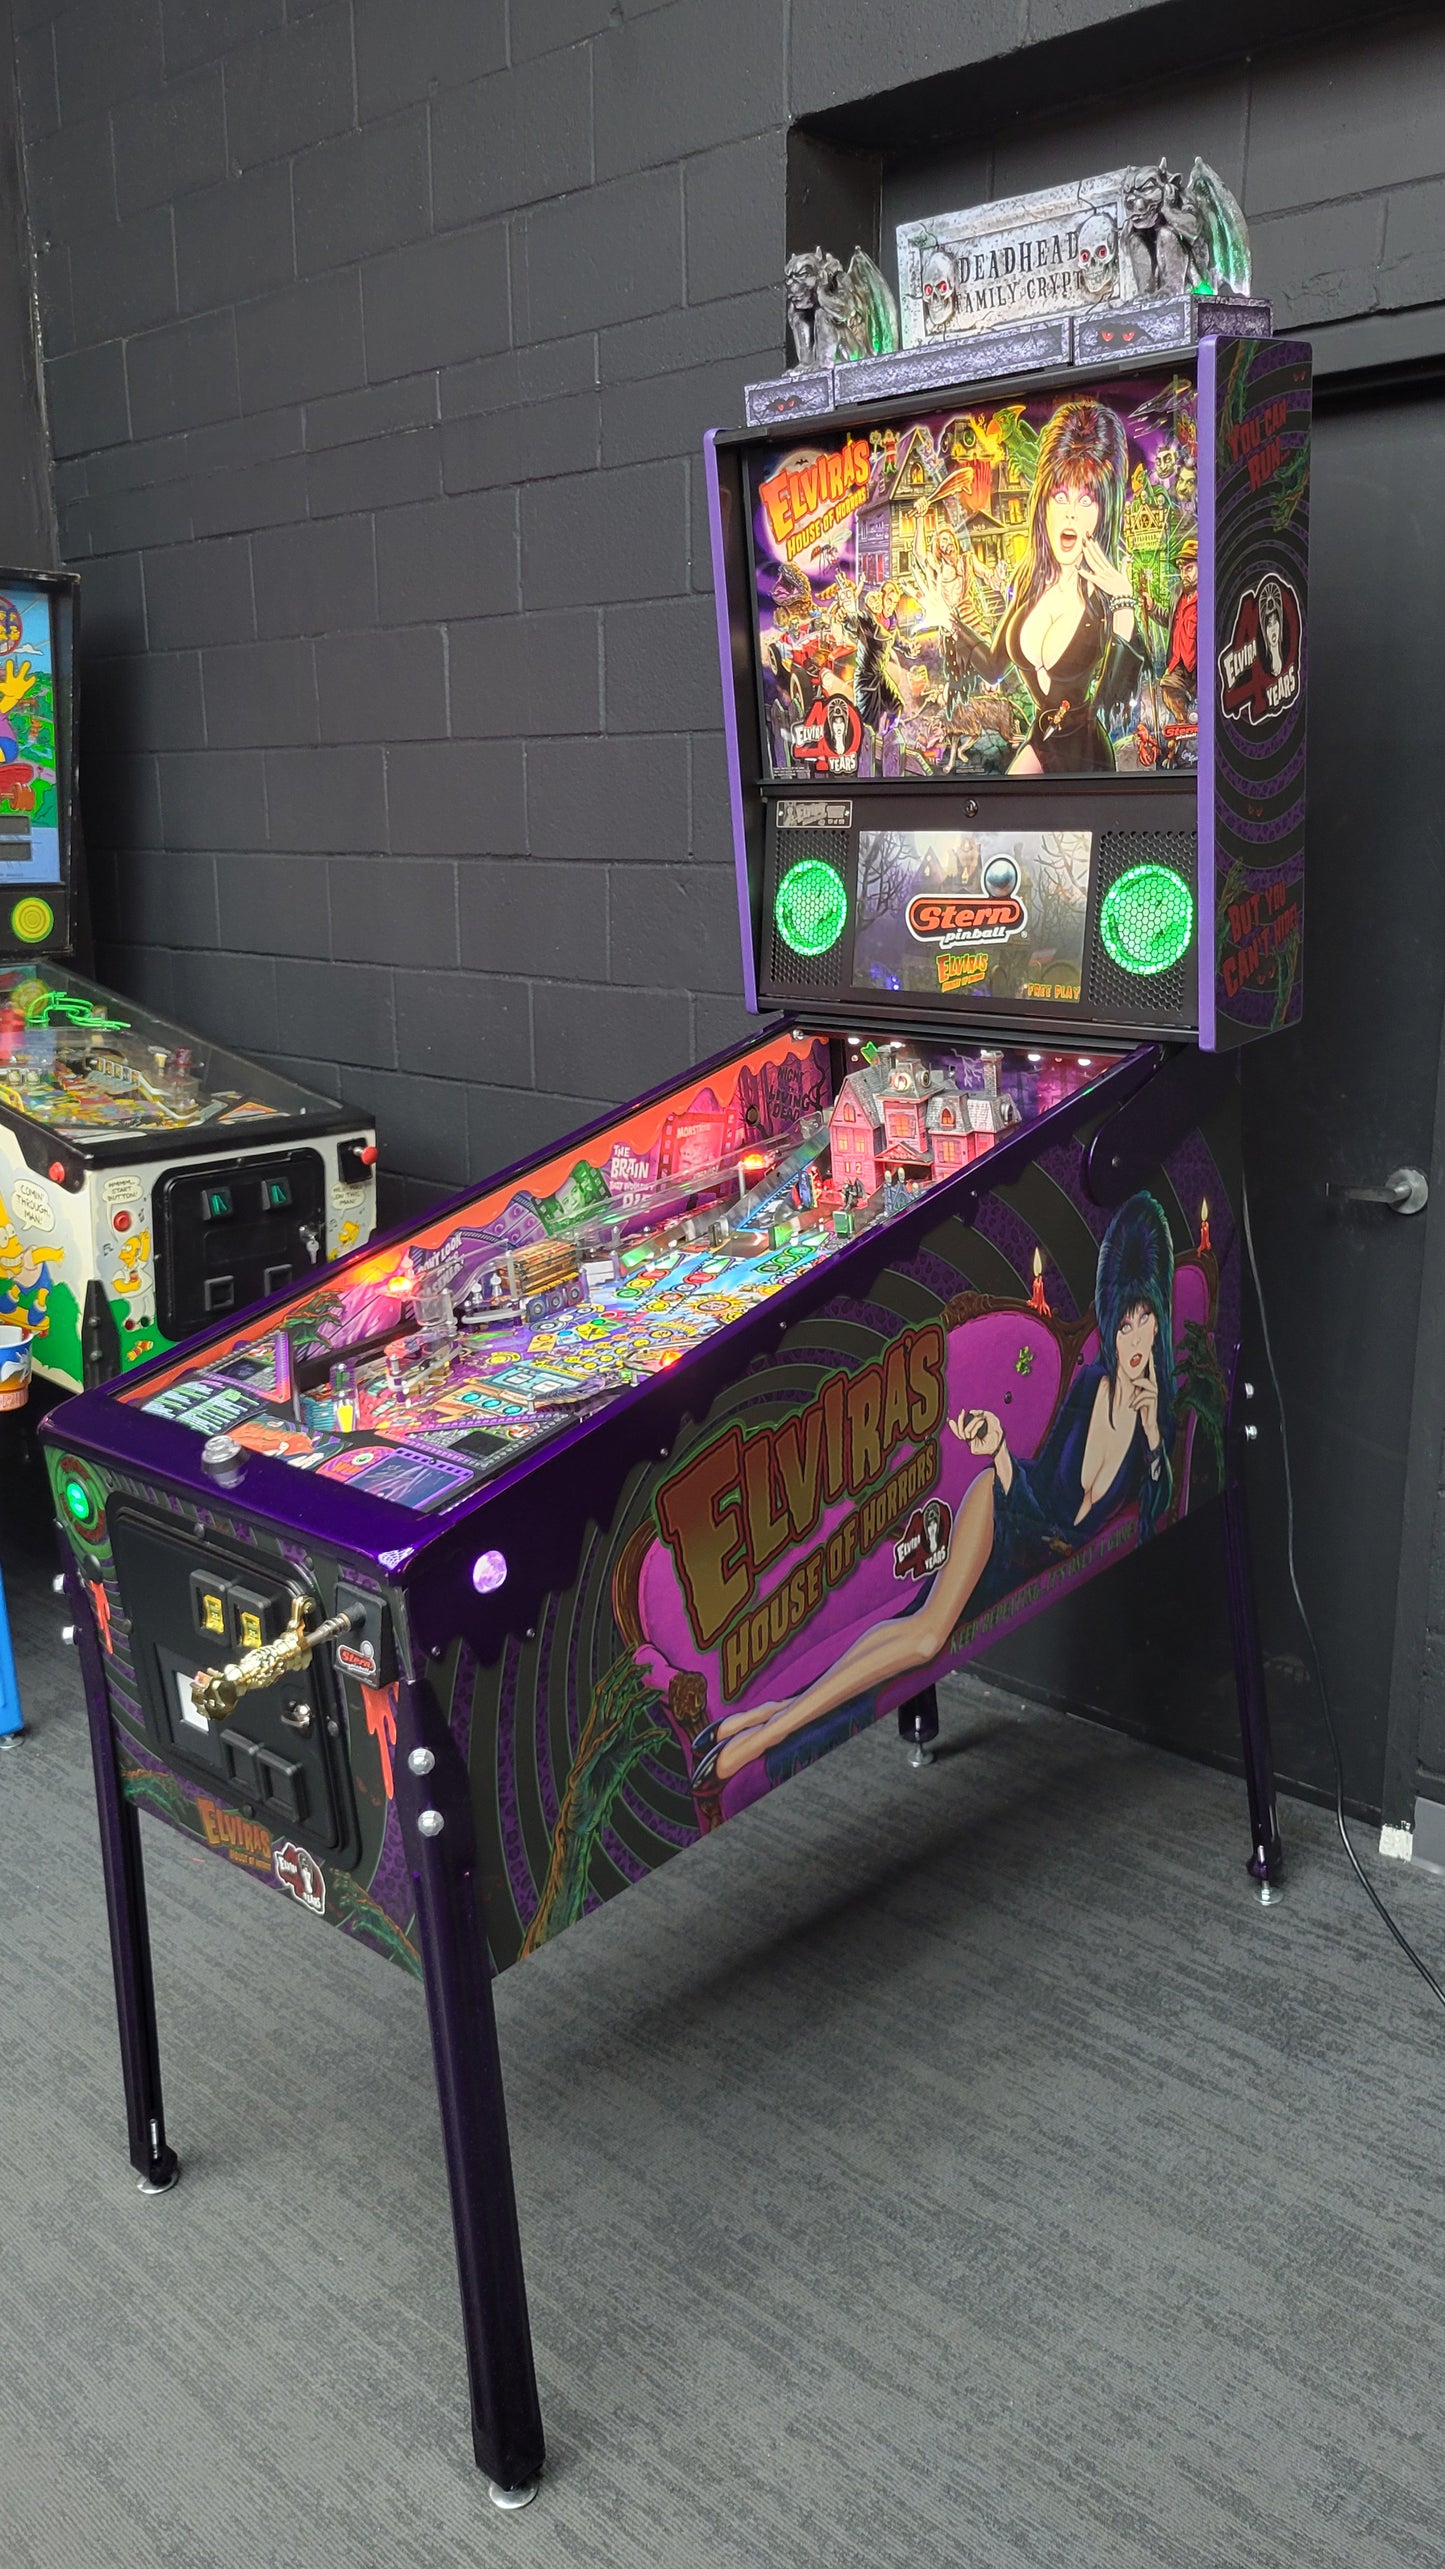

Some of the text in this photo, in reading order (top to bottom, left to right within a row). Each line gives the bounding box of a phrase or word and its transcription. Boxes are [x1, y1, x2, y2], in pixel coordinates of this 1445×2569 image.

[959, 231, 1079, 284] DEADHEAD
[956, 270, 1081, 313] FAMILY CRYPT
[1225, 399, 1288, 463] YOU CAN
[786, 486, 867, 561] HOUSE OF HORRORS
[1224, 638, 1257, 689] ELVIRA
[1266, 666, 1296, 707] YEARS
[829, 754, 857, 772] YEARS
[919, 903, 1014, 929] Stern
[1227, 880, 1287, 943] BUT YOU
[944, 926, 1007, 943] pinball
[1028, 982, 1081, 999] FREE PLAY
[777, 1065, 805, 1083] NIGHT
[769, 1085, 811, 1111] LIVING
[773, 1102, 800, 1121] DEAD
[614, 1144, 631, 1157] THE
[610, 1158, 650, 1179] BRAIN
[441, 1231, 463, 1262] LOOK
[657, 1325, 944, 1650] ELVIRA'S
[721, 1443, 938, 1697] HOUSE OF HORRORS
[342, 1650, 371, 1668] Stern
